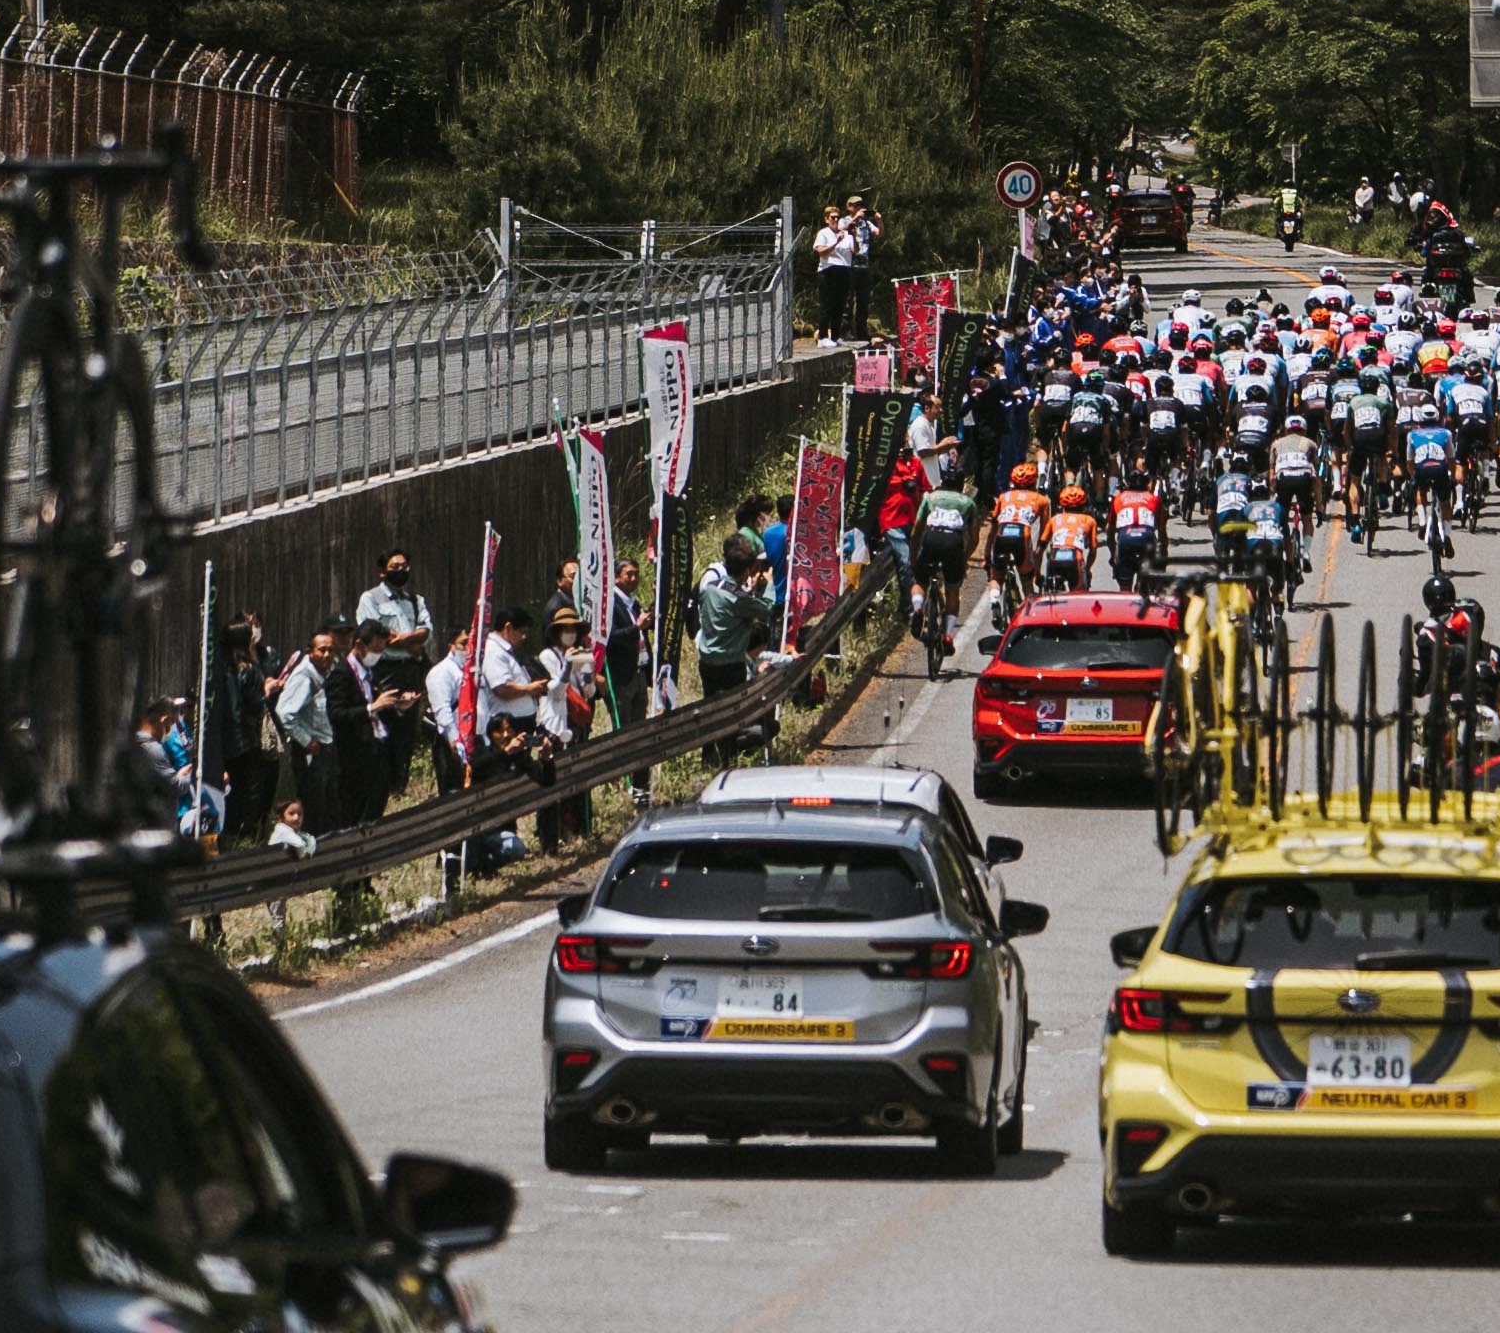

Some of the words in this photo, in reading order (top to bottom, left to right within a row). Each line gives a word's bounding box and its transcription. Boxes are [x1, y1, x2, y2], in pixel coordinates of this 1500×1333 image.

[1007, 176, 1033, 195] 40
[664, 349, 679, 431] NIPPO
[875, 400, 902, 467] Oyama
[1095, 707, 1110, 719] 85
[773, 993, 798, 1012] 84
[725, 1022, 829, 1036] COMMISSAIRE
[1321, 1092, 1404, 1107] NEUTRAL
[1411, 1092, 1448, 1107] CAR
